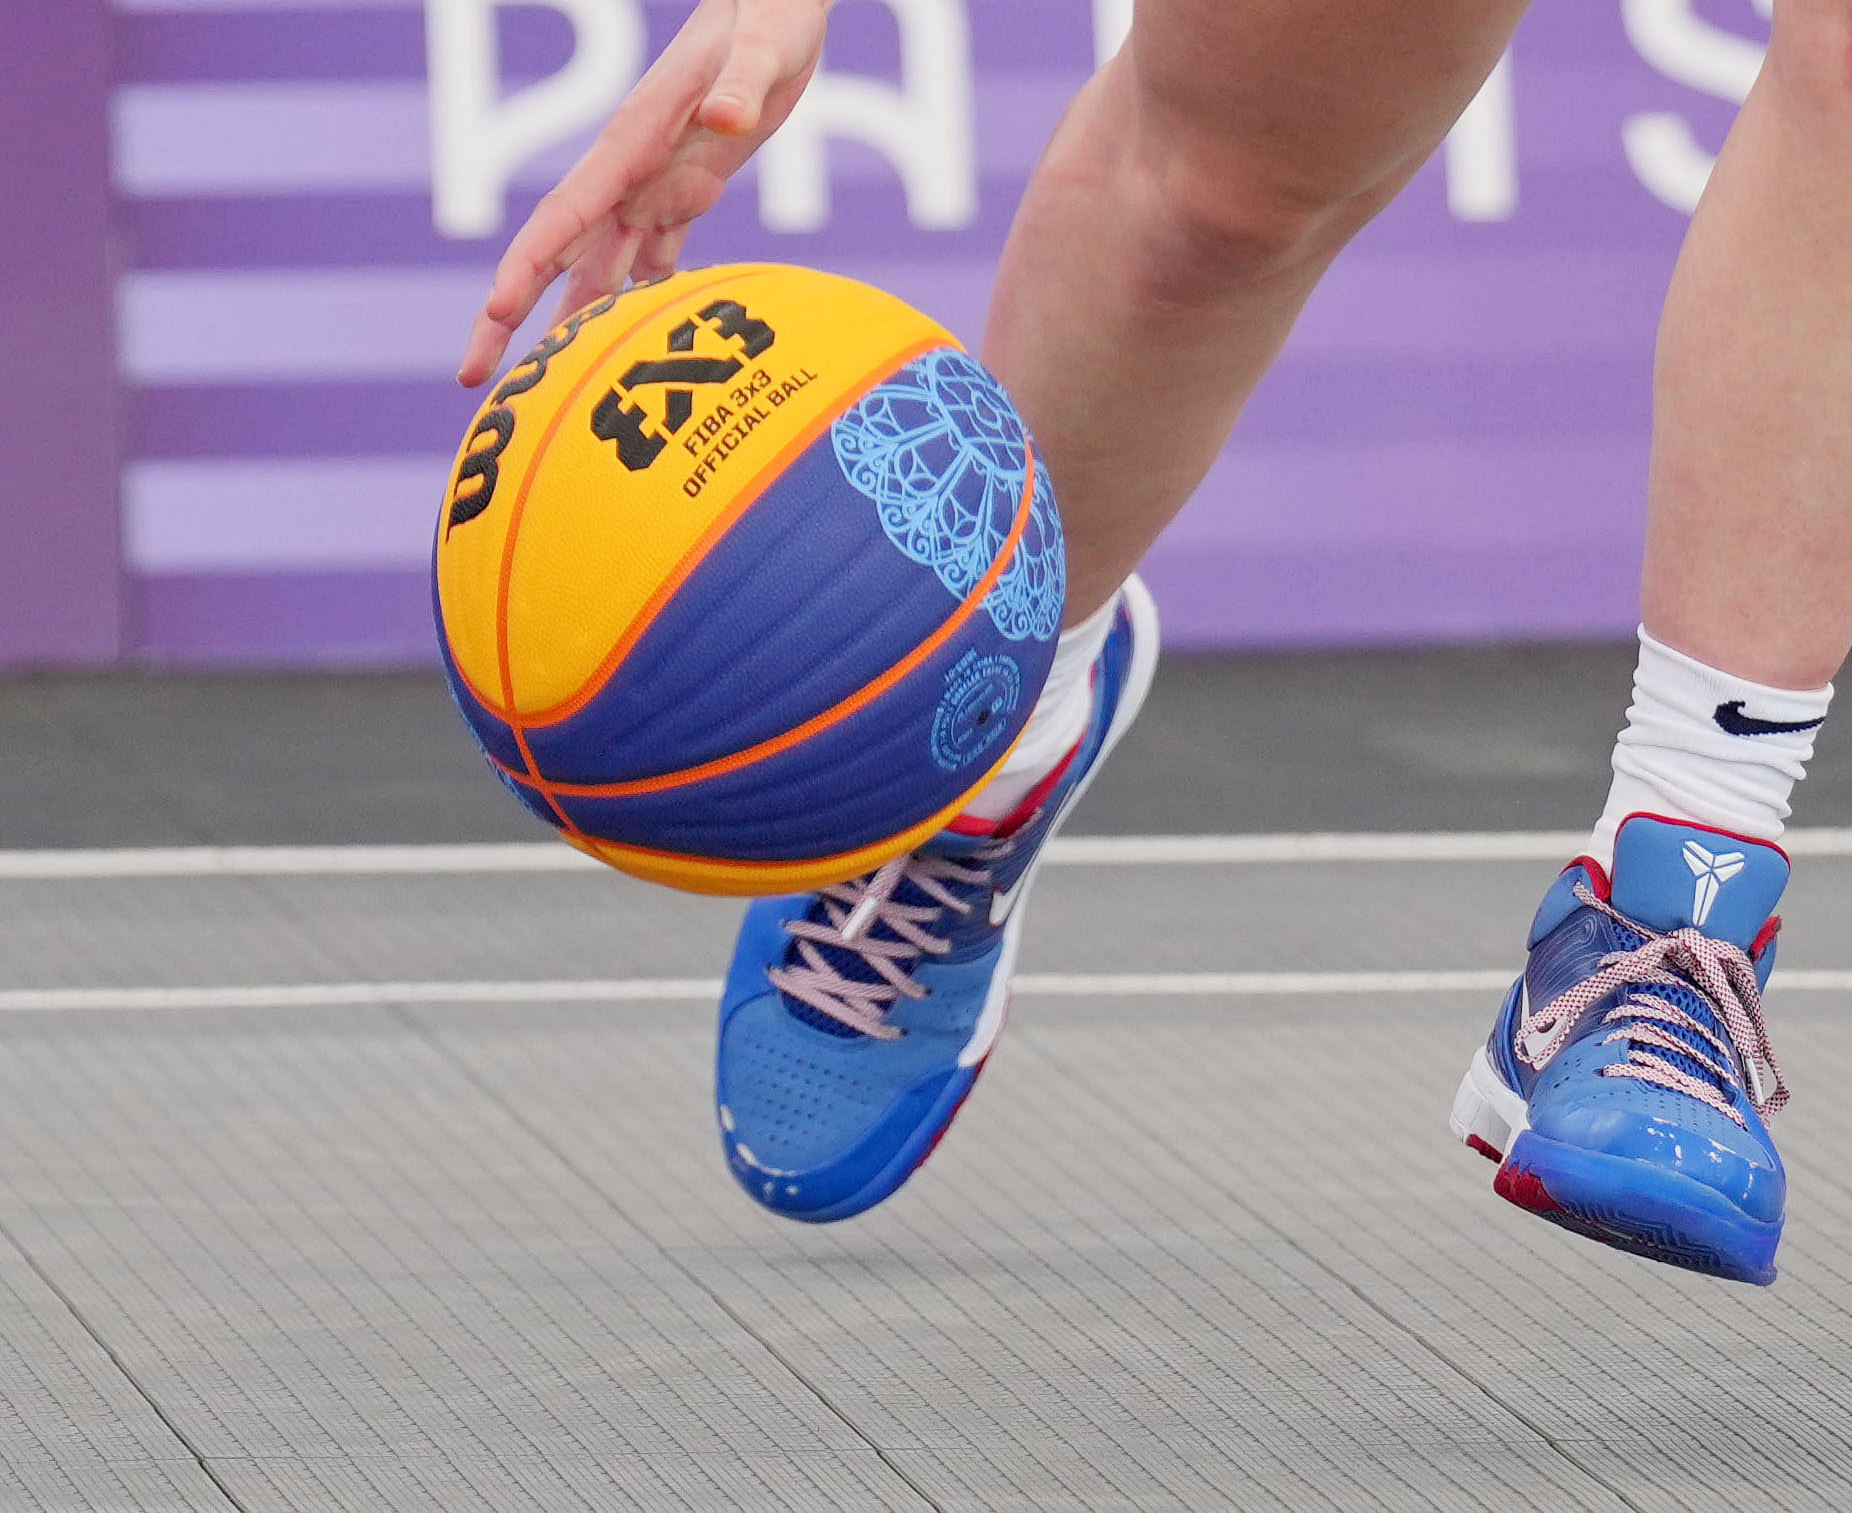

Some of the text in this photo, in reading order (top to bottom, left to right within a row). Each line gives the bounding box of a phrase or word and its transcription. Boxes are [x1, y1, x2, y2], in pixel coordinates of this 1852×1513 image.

[682, 369, 772, 457] FIBA 3x3
[682, 368, 818, 498] OFFICIAL BALL
